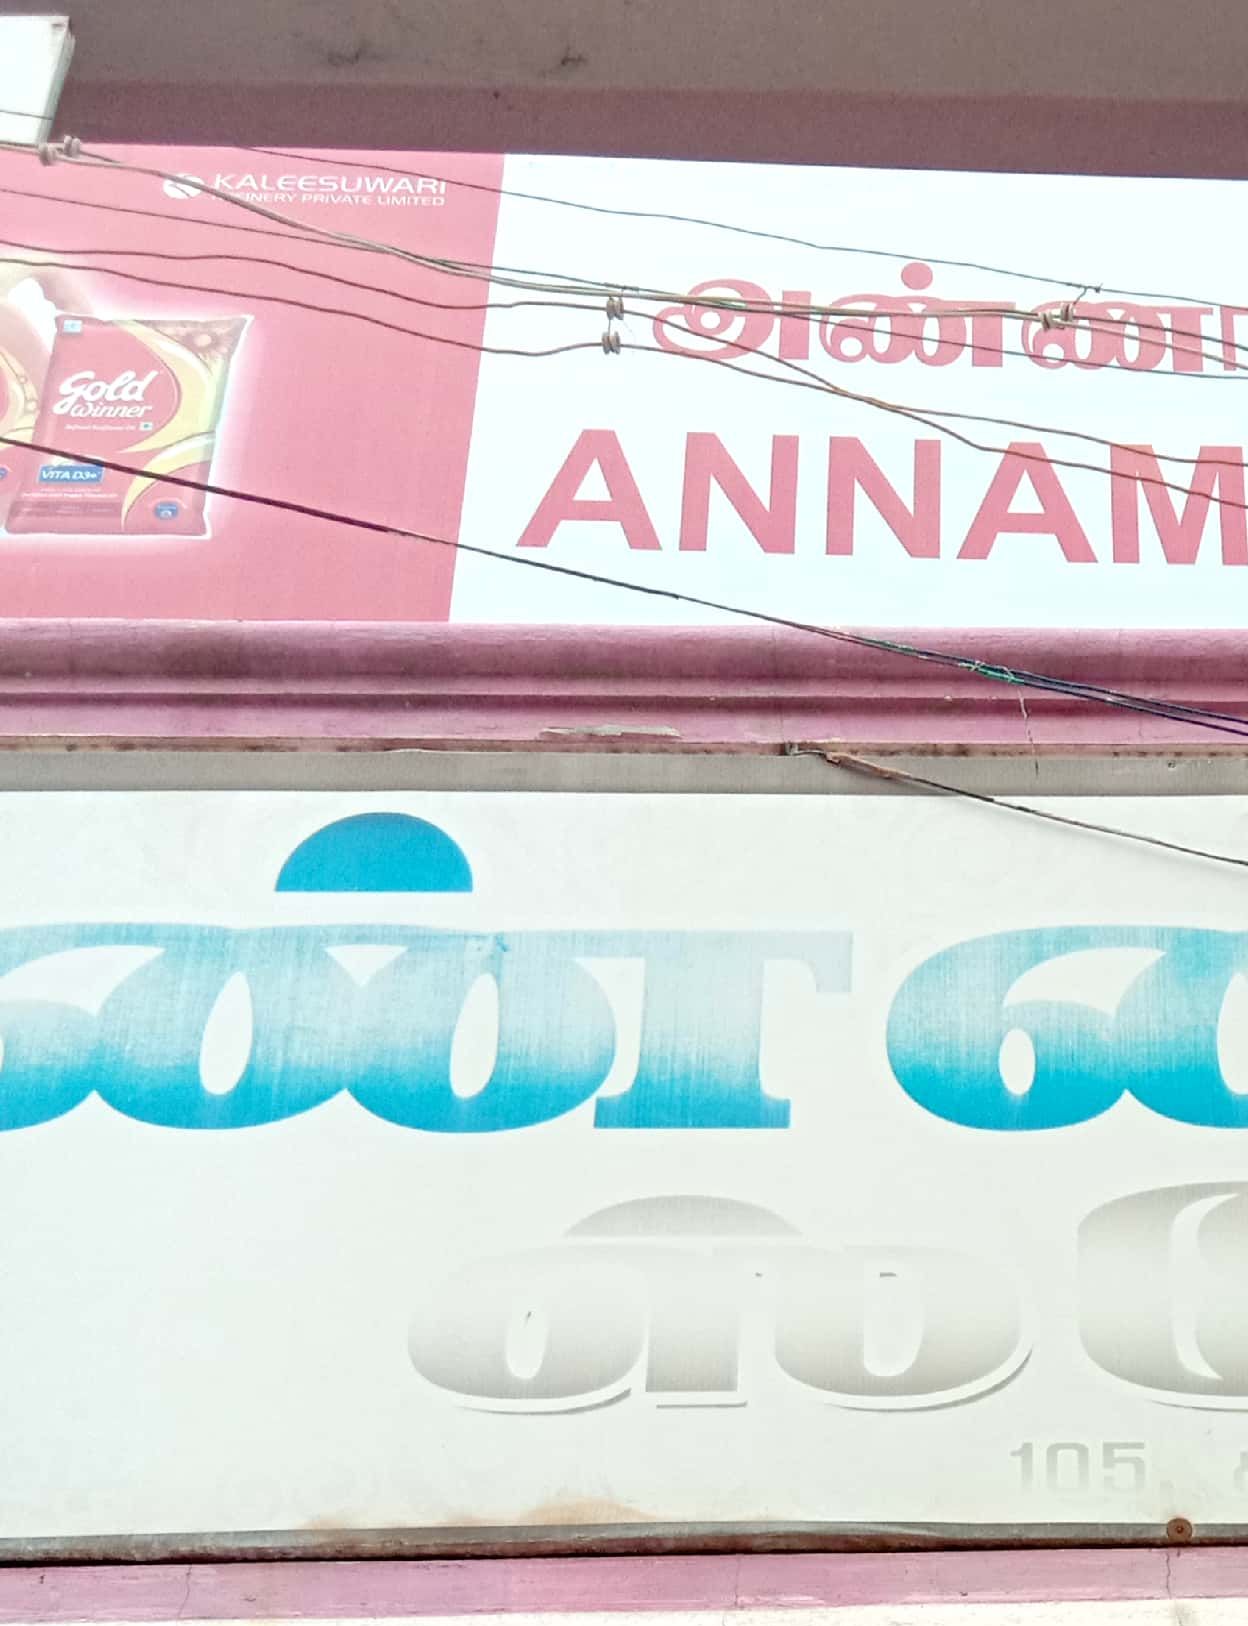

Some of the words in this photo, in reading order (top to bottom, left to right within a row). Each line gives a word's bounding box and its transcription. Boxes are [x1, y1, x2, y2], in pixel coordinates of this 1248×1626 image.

[212, 173, 446, 195] KALEESUWARI
[302, 192, 371, 206] PRIVATE
[375, 194, 445, 207] LIMITED
[52, 371, 158, 414] Gold
[41, 470, 71, 480] VITA
